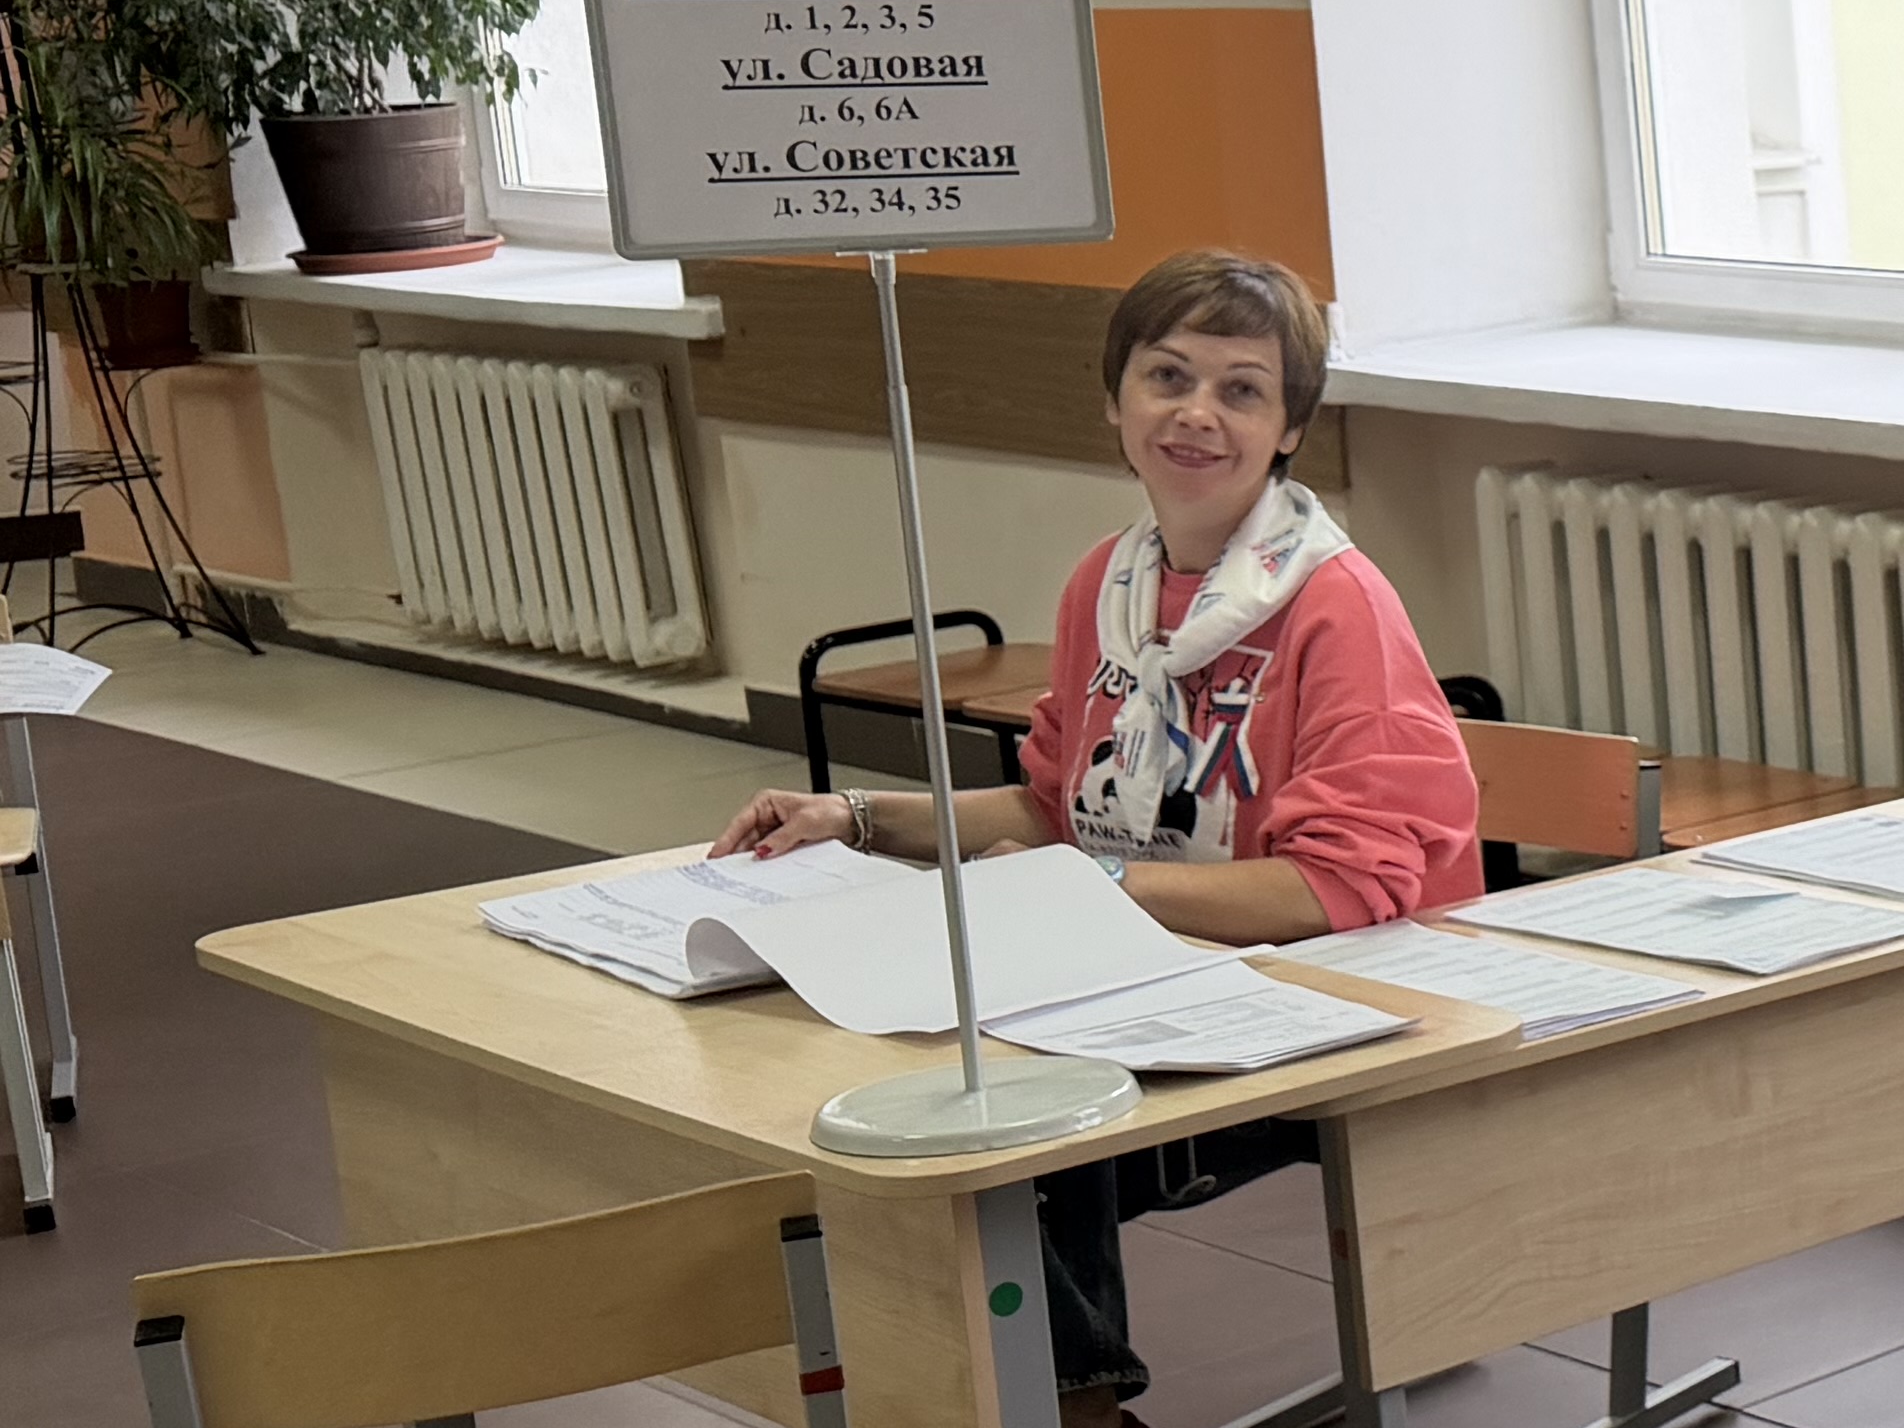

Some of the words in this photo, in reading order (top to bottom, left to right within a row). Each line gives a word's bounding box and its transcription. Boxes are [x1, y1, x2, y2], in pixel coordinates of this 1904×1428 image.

[764, 13, 792, 34] д.
[807, 5, 831, 35] 1,
[842, 5, 869, 34] 2,
[879, 4, 907, 32] 3,
[917, 4, 935, 29] 5
[720, 56, 785, 83] ул.
[800, 48, 986, 83] Садовая
[798, 103, 827, 125] д.
[837, 97, 865, 125] 6,
[875, 96, 920, 122] 6А
[706, 149, 771, 178] ул.
[785, 139, 1017, 173] Советская
[773, 196, 803, 219] д.
[813, 189, 860, 218] 32,
[869, 187, 916, 217] 34,
[925, 185, 961, 212] 35
